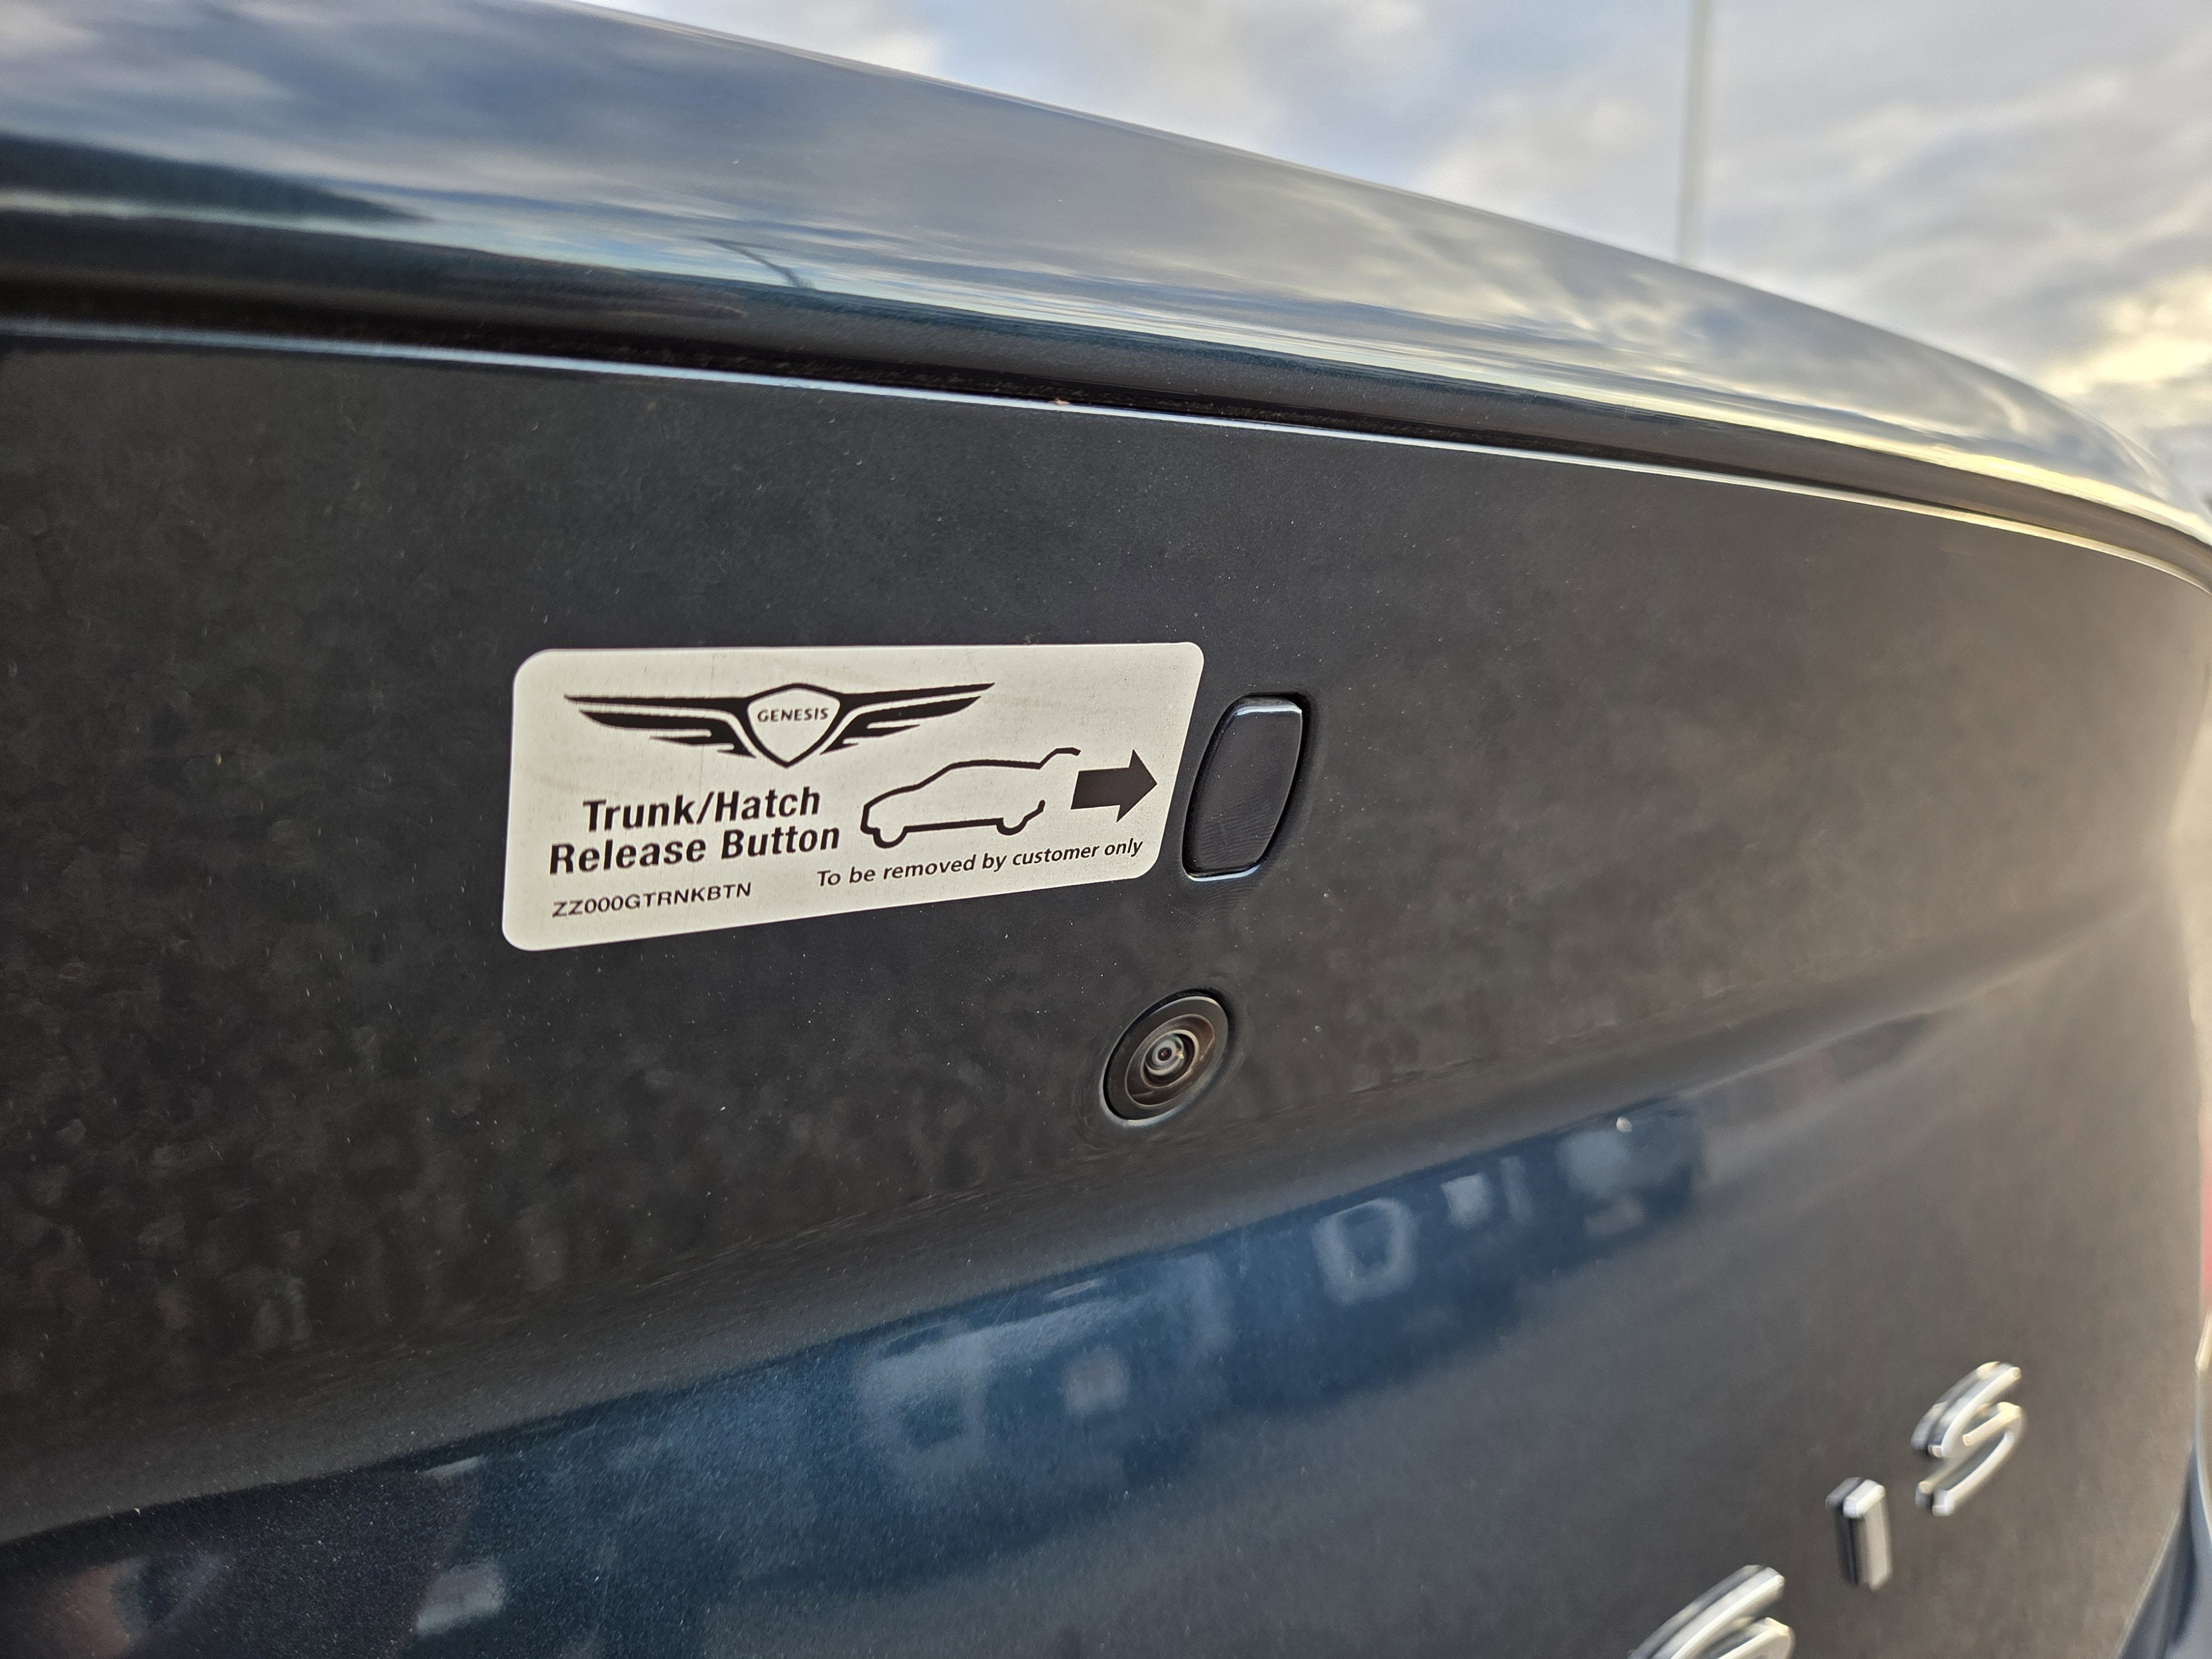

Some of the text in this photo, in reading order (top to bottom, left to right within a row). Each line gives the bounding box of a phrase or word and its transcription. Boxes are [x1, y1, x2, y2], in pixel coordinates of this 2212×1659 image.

[757, 707, 829, 722] GENESIS
[582, 785, 820, 833] Trunk/Hatch
[550, 825, 840, 875] Release Button
[816, 837, 1144, 887] To be removed by customer only
